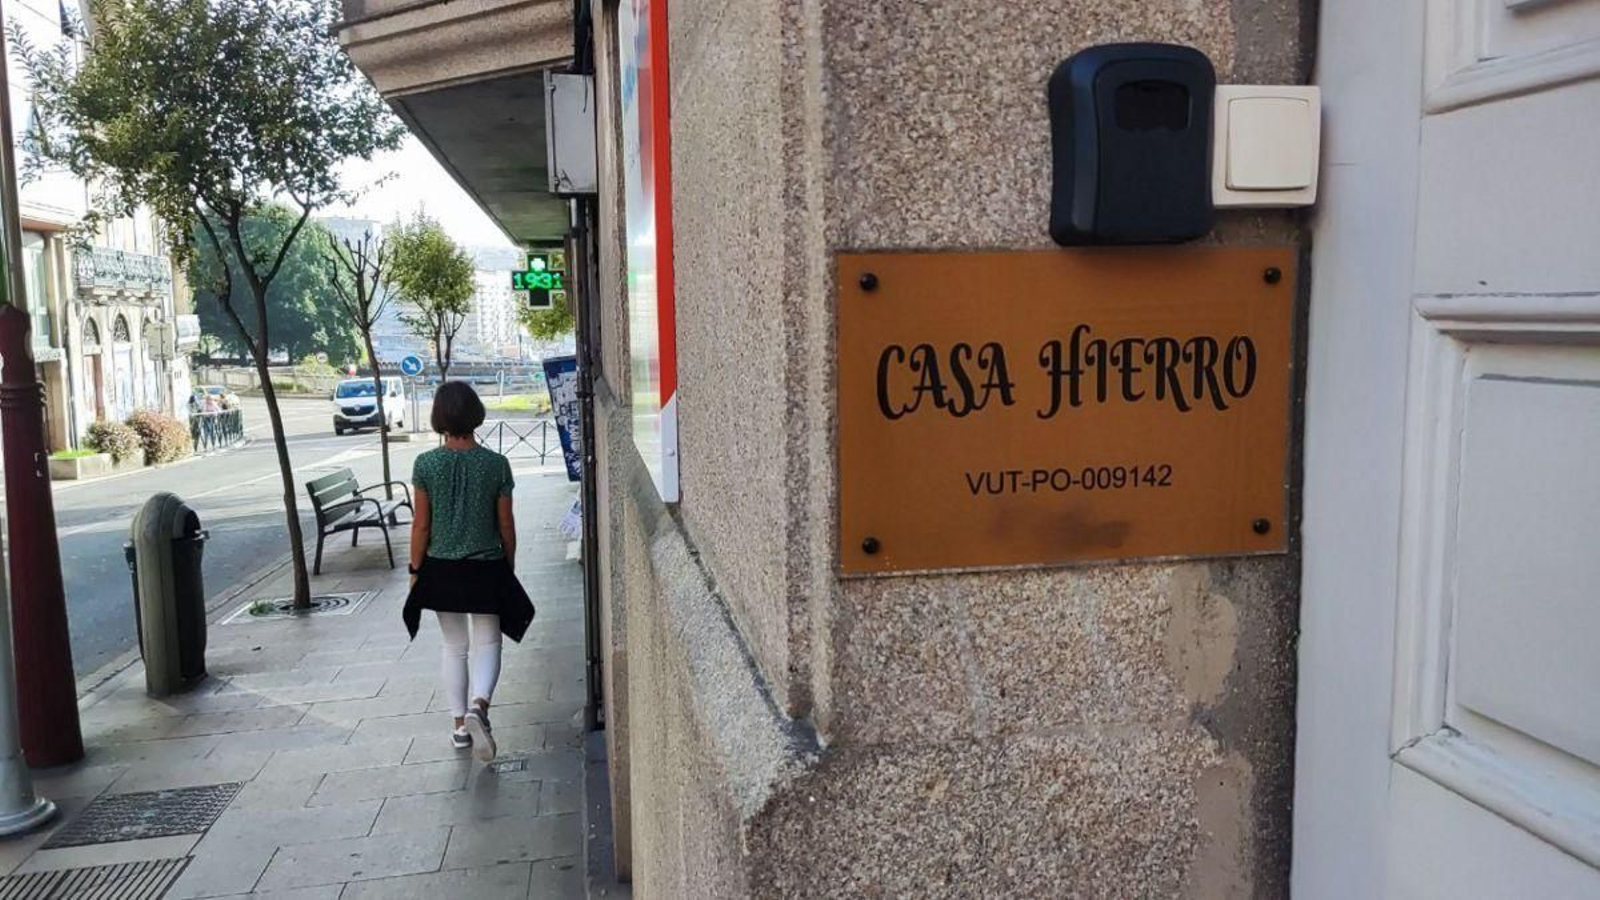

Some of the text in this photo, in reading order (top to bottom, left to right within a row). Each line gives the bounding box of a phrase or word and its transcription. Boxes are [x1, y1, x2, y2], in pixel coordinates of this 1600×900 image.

[877, 324, 1257, 421] CASA HIERRO
[966, 464, 1173, 497] VUT-PO-009142
